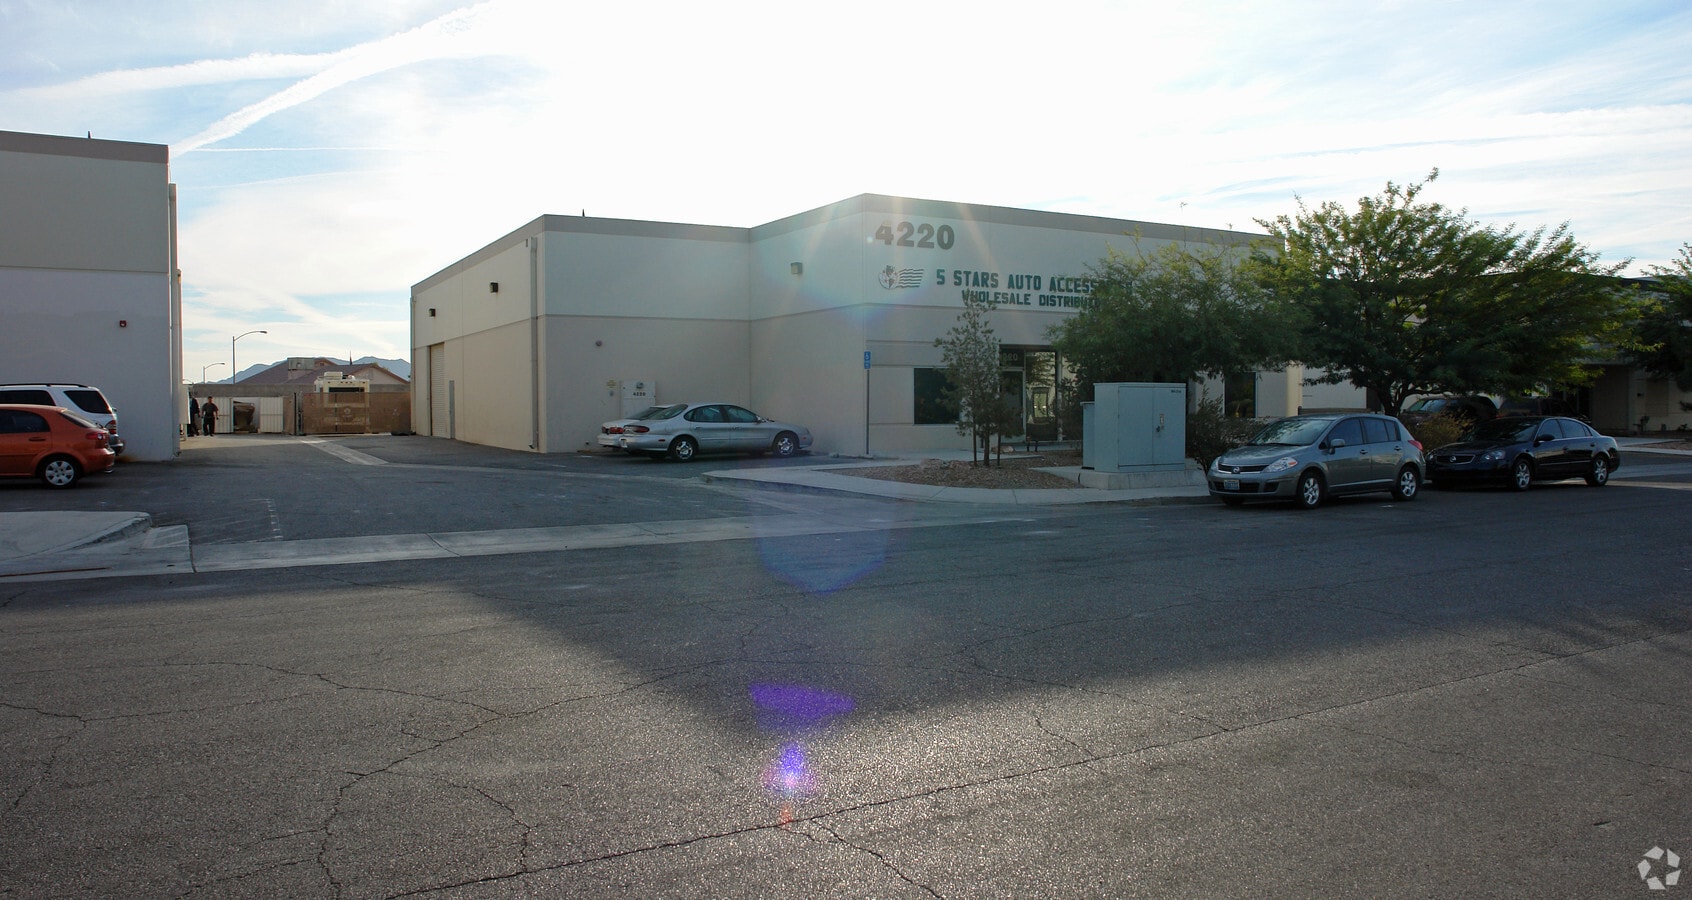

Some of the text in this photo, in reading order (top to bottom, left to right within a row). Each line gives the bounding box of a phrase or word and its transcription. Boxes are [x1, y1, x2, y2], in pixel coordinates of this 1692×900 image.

[875, 220, 955, 250] 4220
[936, 268, 945, 286] 5
[953, 269, 999, 289] STARS
[1007, 273, 1042, 291] AUTO
[961, 289, 1031, 306] WHOLESALE
